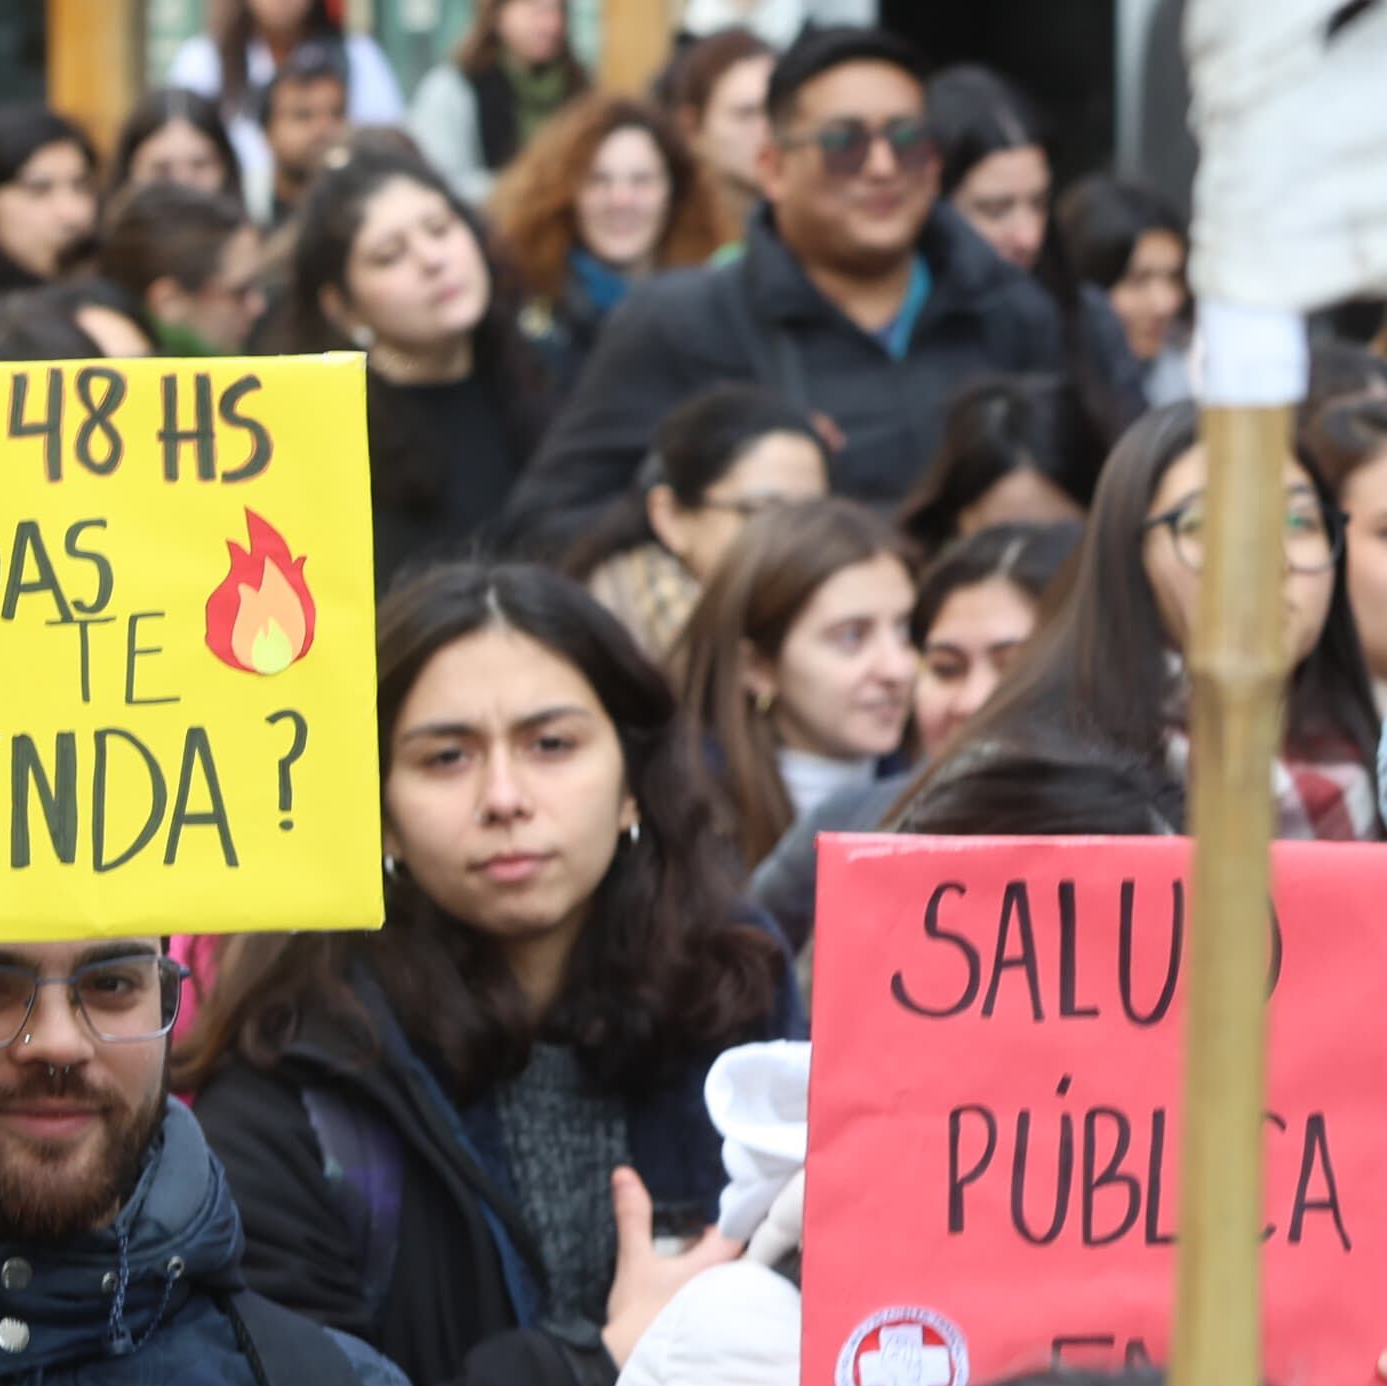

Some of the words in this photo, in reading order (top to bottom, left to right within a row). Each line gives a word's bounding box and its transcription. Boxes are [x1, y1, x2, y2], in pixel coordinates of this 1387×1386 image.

[7, 366, 127, 483] 48
[157, 374, 274, 484] HS
[44, 611, 181, 705] TE
[891, 878, 1284, 1028] SALU
